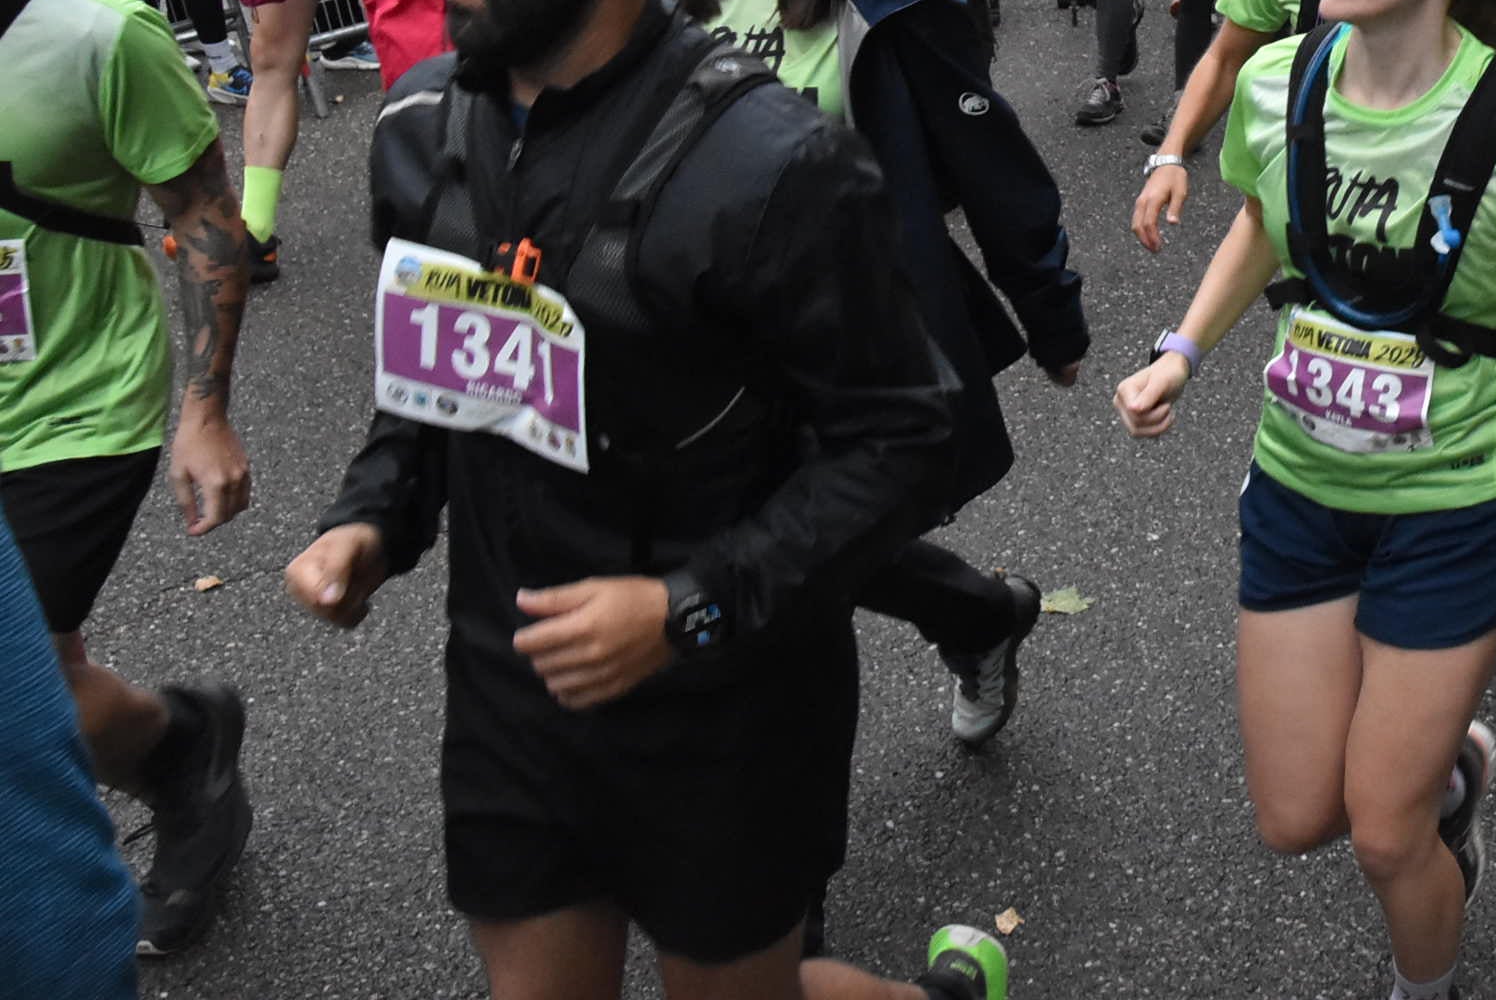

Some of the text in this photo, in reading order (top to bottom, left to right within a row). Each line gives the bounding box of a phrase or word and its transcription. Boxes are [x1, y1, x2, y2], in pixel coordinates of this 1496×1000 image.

[410, 302, 555, 407] 1341
[1317, 329, 1373, 361] VETONA
[1285, 349, 1403, 424] 1343
